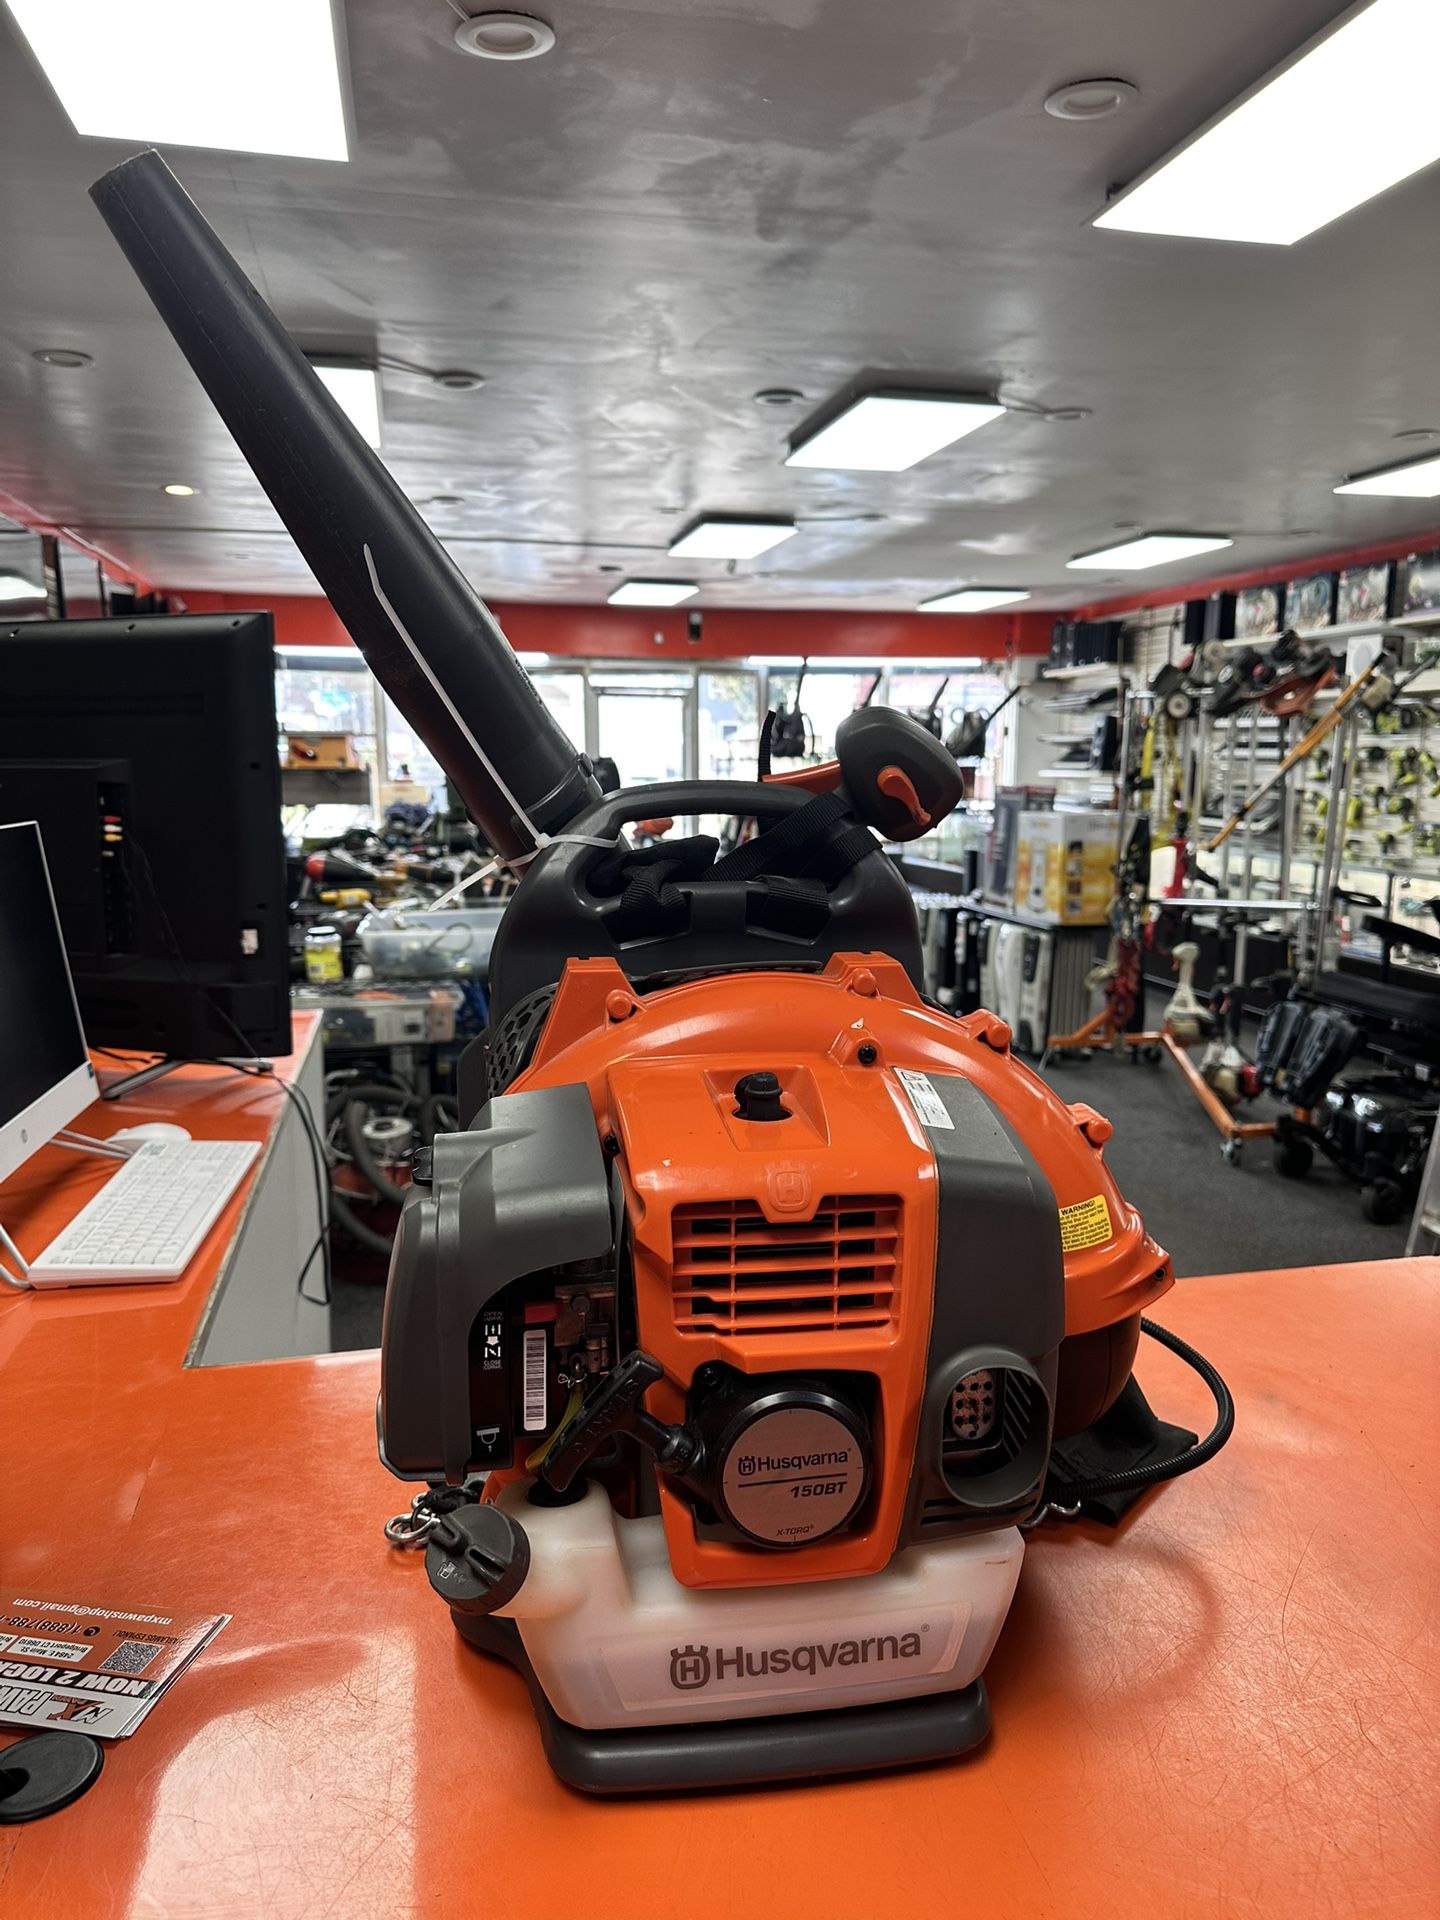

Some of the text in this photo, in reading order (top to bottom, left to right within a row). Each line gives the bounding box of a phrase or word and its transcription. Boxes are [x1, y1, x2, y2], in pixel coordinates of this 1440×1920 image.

[1061, 1200, 1095, 1215] WARNING!
[757, 1451, 848, 1471] Husqvarna
[790, 1481, 847, 1498] 150BT
[776, 1526, 810, 1536] X-TORQ
[13, 1598, 173, 1625] mxpawnshop@gmail.com
[715, 1632, 921, 1680] Husqvarna
[55, 1670, 80, 1685] 2
[74, 1674, 148, 1696] NOW
